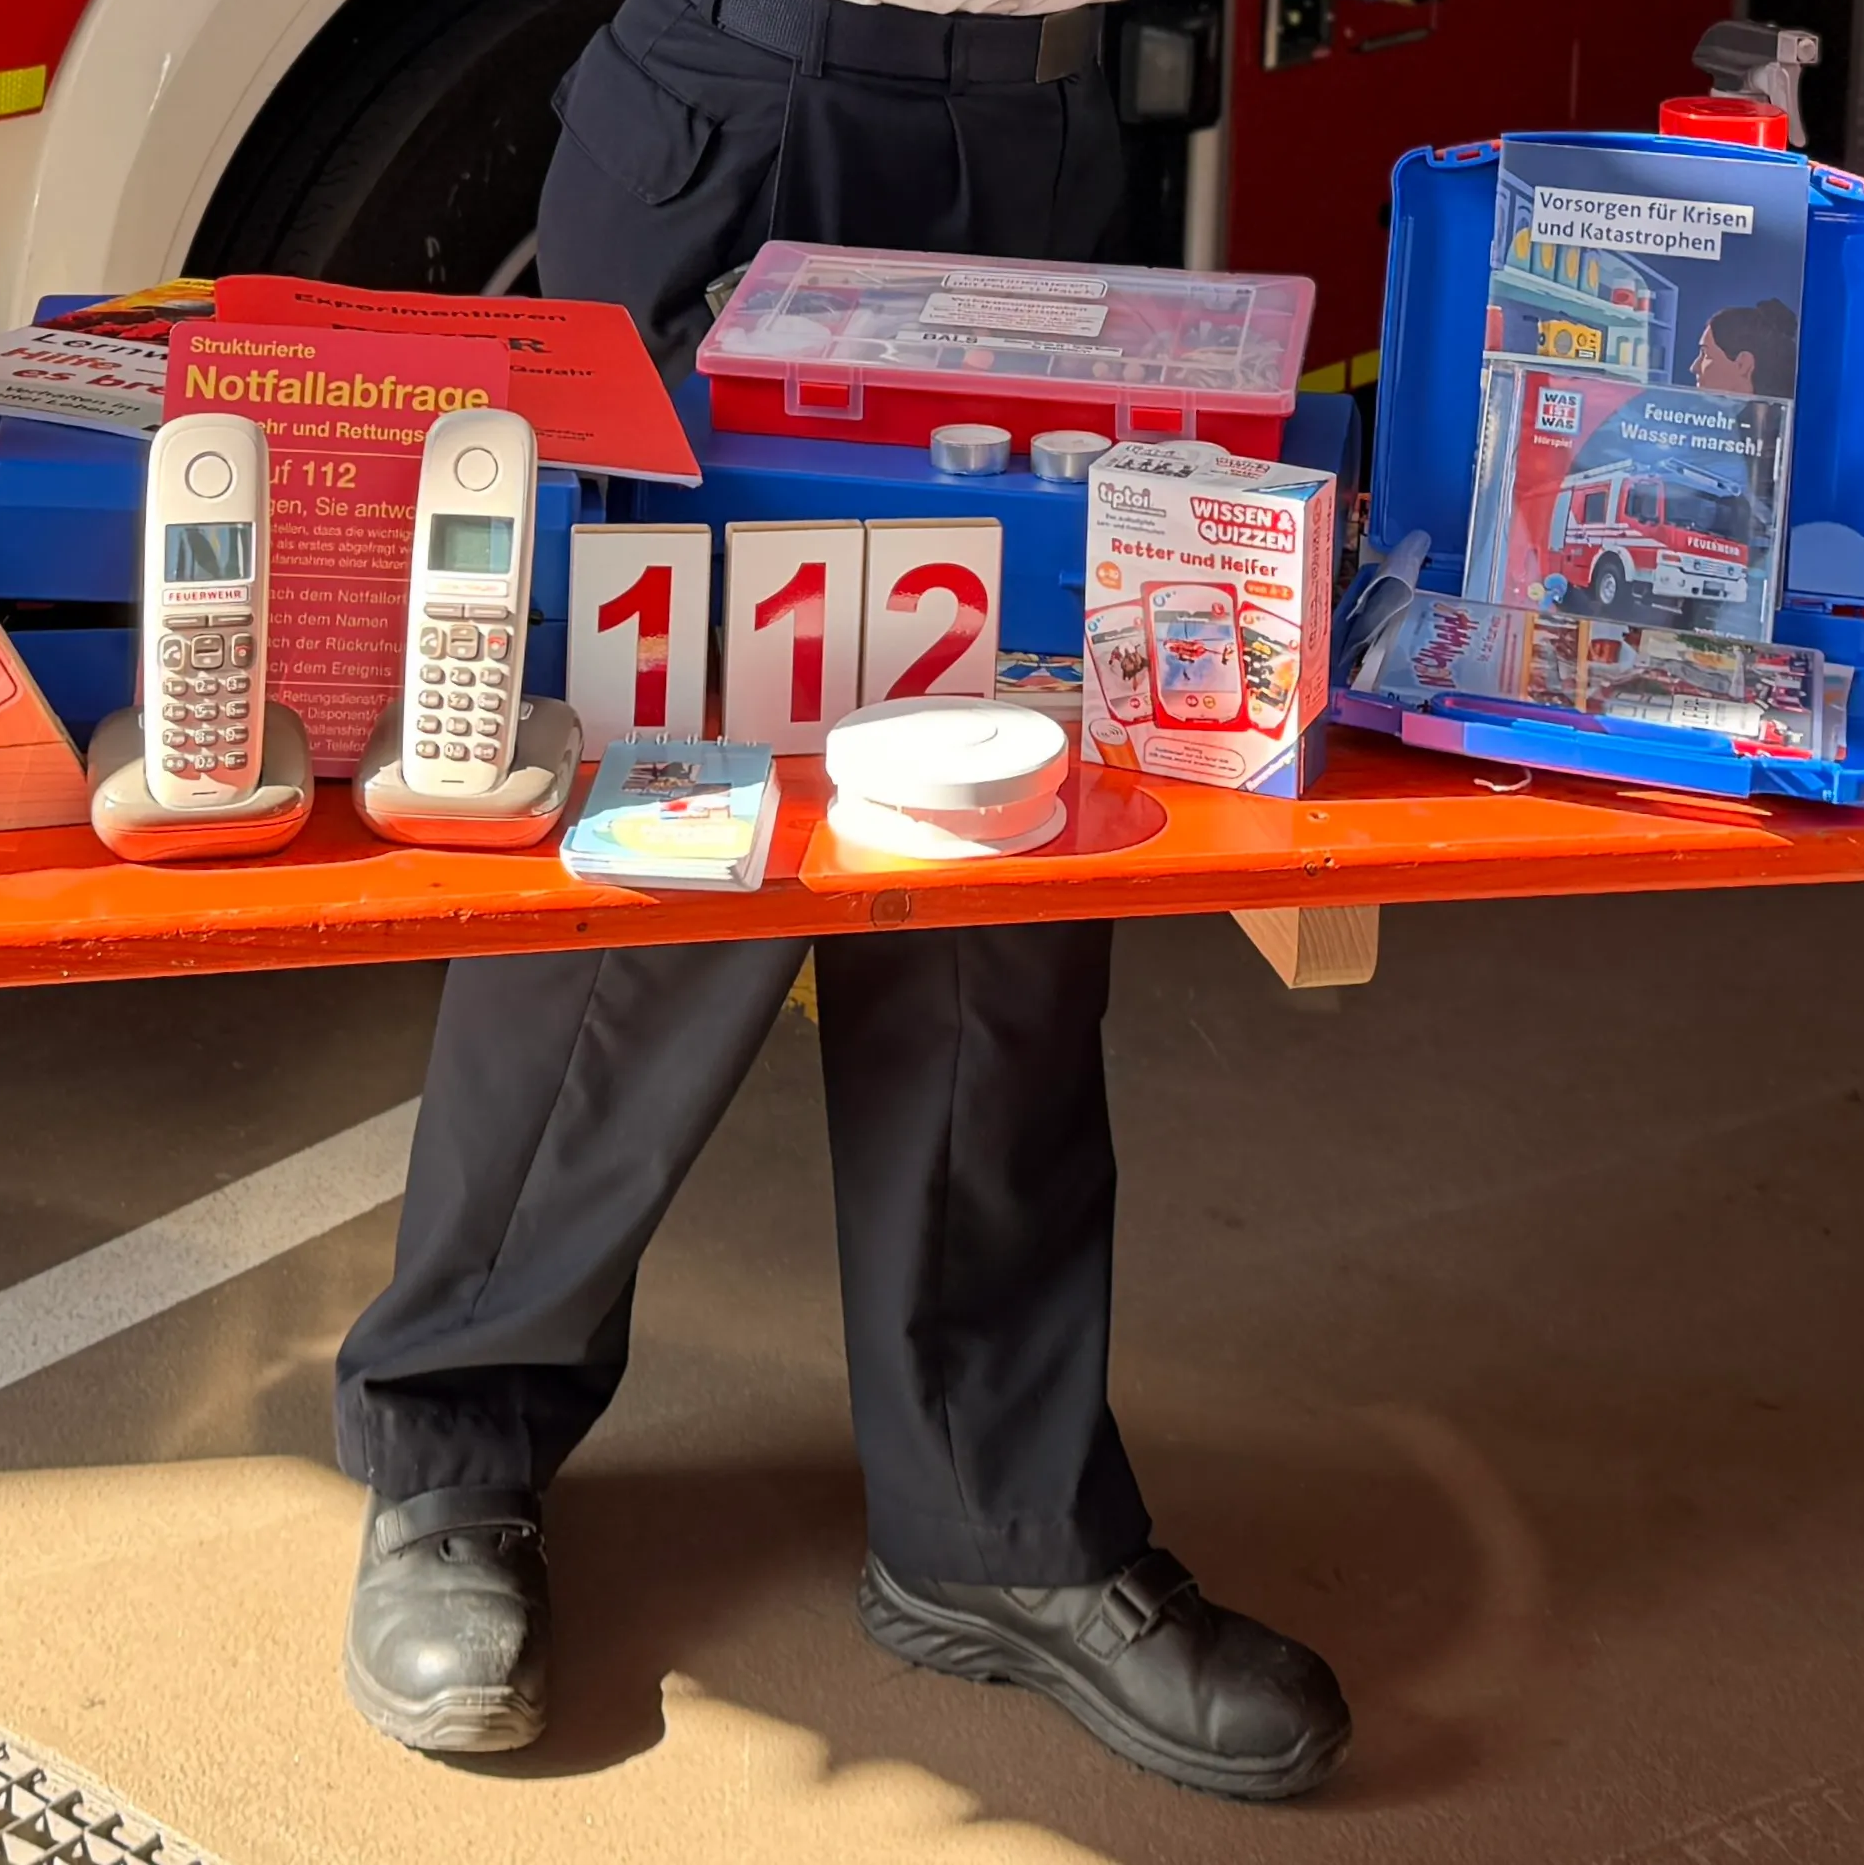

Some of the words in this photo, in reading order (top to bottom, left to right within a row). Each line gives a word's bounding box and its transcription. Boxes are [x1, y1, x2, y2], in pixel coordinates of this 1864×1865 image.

[1539, 191, 1642, 226] Vorsorgen
[1647, 199, 1678, 224] für
[1682, 204, 1749, 230] Krisen
[1536, 217, 1575, 240] und
[1580, 221, 1717, 257] Katastrophen
[294, 292, 568, 323] Experimentieren
[190, 336, 316, 360] Strukturierte
[12, 368, 78, 383] es
[5, 385, 109, 406] Verhalten
[184, 364, 490, 415] Notfallabfrage
[1544, 392, 1577, 406] WAS
[1546, 405, 1571, 418] IST
[1644, 403, 1735, 431] Feuerwehr
[293, 420, 330, 438] und
[1542, 416, 1575, 430] WAS
[1533, 434, 1573, 449] Hörspiel
[1620, 421, 1687, 446] Wasser
[1691, 433, 1764, 458] marsch!
[302, 460, 357, 489] 112
[315, 496, 349, 517] Sie
[1098, 482, 1151, 511] tiptoi
[1193, 498, 1272, 529] WISSEN
[1276, 509, 1296, 532] &
[1199, 520, 1295, 553] QUIZZEN
[1687, 536, 1741, 557] FEUERWEHR
[1111, 537, 1176, 561] Retter
[1180, 551, 1215, 570] und
[1221, 554, 1279, 578] Helfer
[168, 589, 242, 602] FEUERWEHR
[300, 588, 333, 603] dem
[337, 589, 408, 606] Notfallort
[297, 613, 331, 627] dem
[335, 613, 389, 629] Namen
[295, 637, 322, 650] der
[293, 661, 327, 675] dem
[331, 661, 393, 679] Ereignis
